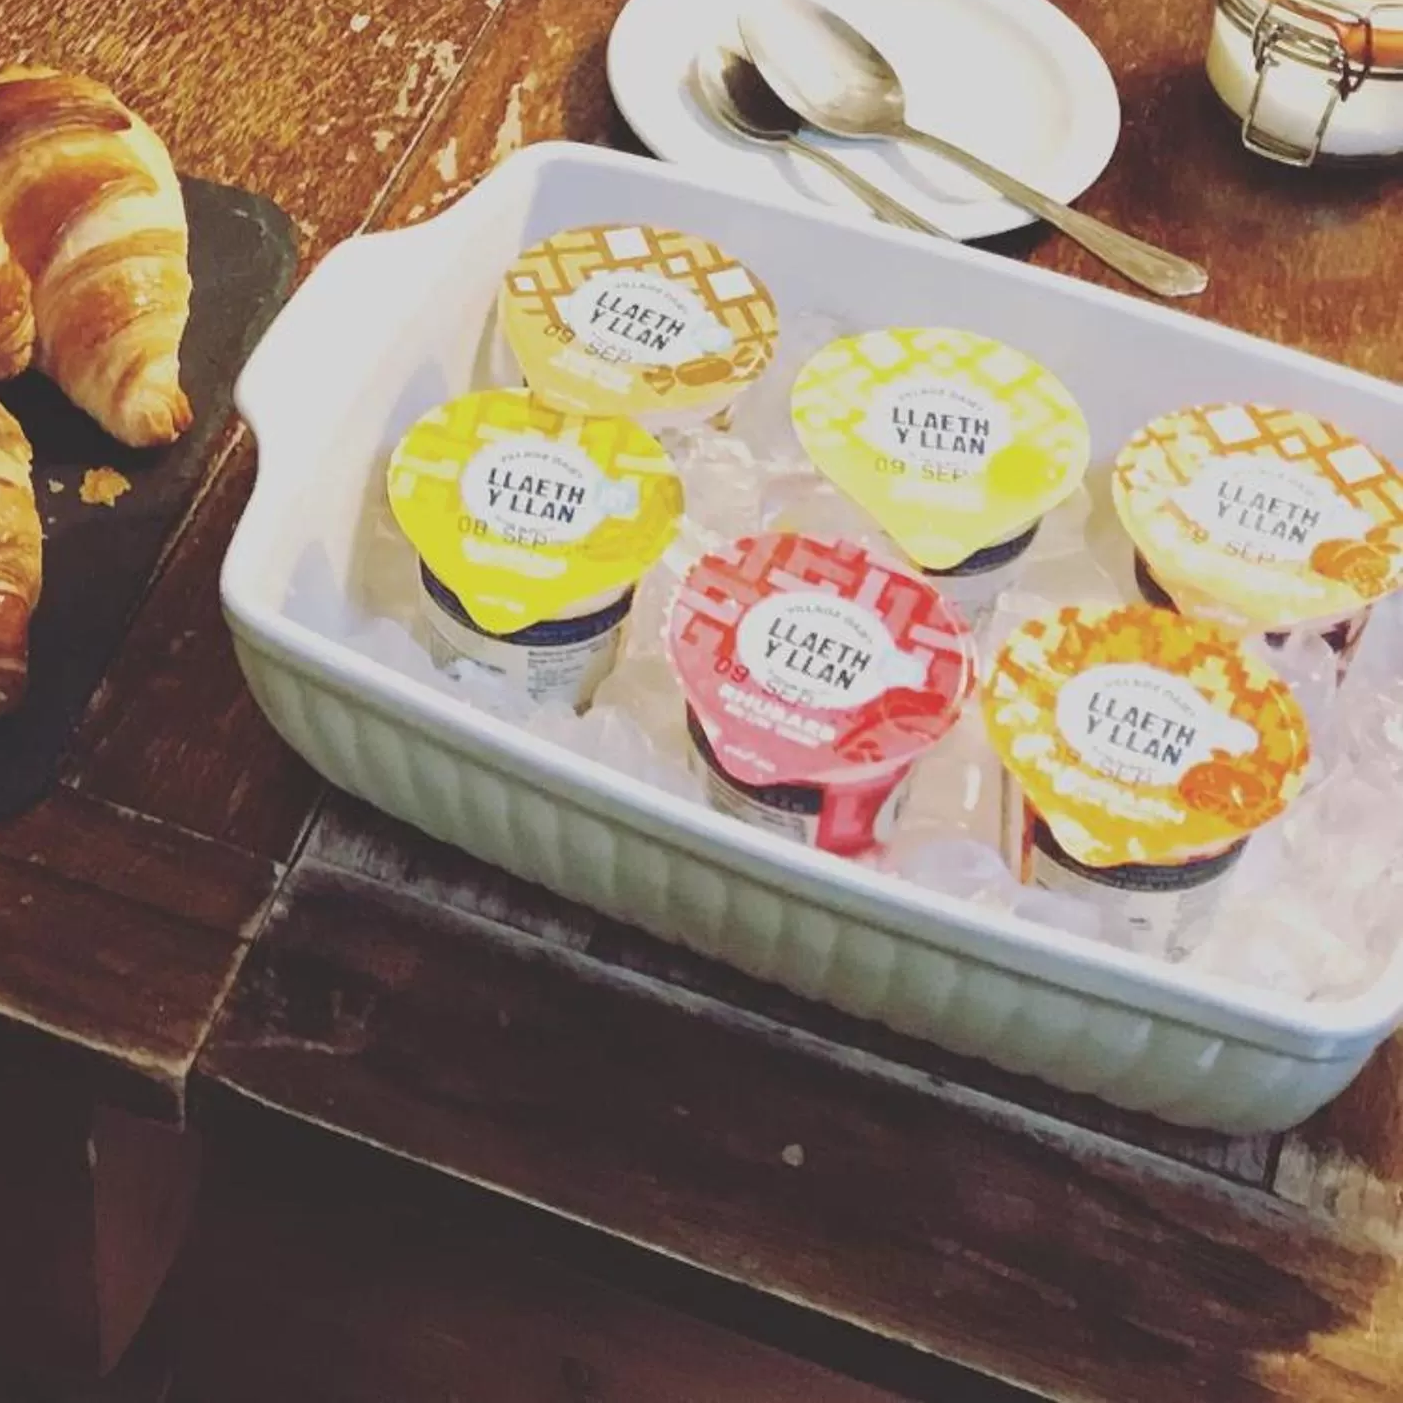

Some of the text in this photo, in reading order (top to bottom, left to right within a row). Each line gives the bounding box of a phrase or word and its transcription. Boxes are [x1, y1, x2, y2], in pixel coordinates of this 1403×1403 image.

[590, 308, 671, 351] Y LLAN
[596, 291, 685, 337] LLAETH
[544, 325, 632, 364] 09 SEP
[892, 407, 990, 436] LLAETH
[897, 428, 985, 455] Y LLAN
[488, 467, 585, 504] LLAETH
[875, 457, 971, 483] 09 SEP
[489, 488, 575, 523] Y LLAN
[1217, 501, 1308, 543] Y LLAN
[1218, 481, 1320, 527] LLAETH
[503, 524, 547, 550] SEP
[764, 639, 856, 690] Y LLAN
[768, 617, 871, 672] LLAETH
[714, 657, 749, 683] 09
[1088, 692, 1196, 747] LLAETH
[1087, 714, 1182, 766] Y LLAN
